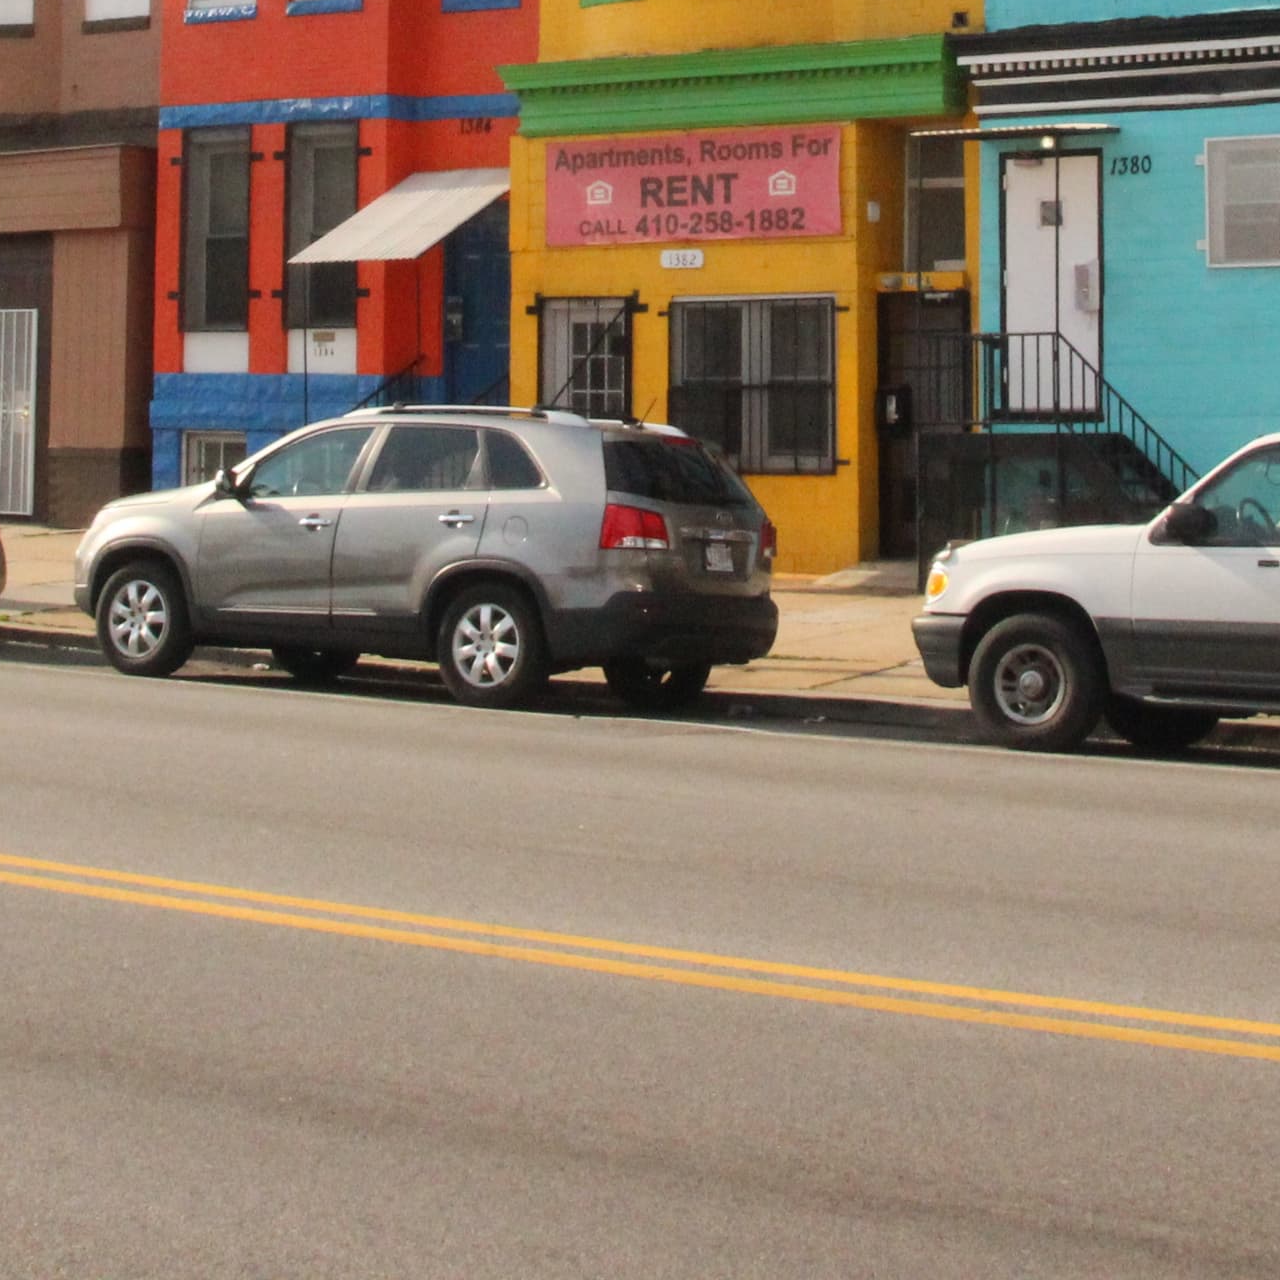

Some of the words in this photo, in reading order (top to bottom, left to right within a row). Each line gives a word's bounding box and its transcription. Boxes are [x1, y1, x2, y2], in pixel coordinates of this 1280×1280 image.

[555, 144, 692, 174] Apartments,
[700, 137, 783, 162] Rooms
[792, 133, 833, 158] For
[1110, 154, 1152, 176] 1380
[640, 173, 738, 208] RENT
[580, 219, 627, 237] CALL
[635, 207, 805, 237] 410-258-1882
